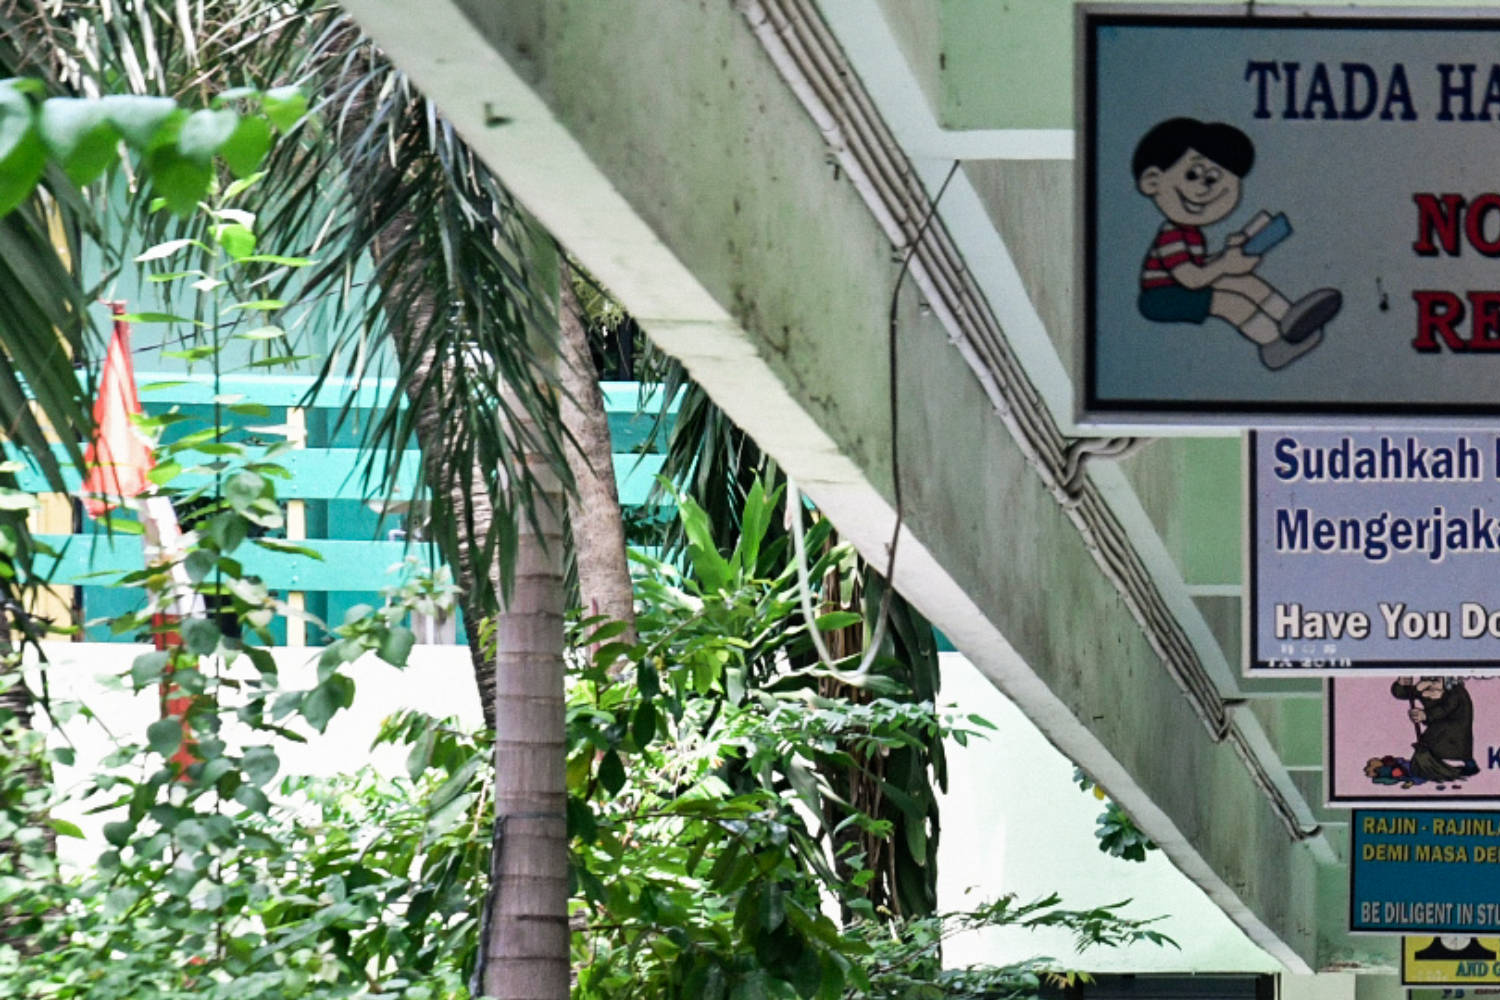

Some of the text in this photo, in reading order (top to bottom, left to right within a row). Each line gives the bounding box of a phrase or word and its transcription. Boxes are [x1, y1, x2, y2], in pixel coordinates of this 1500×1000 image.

[1244, 60, 1418, 120] TIADA
[1274, 437, 1481, 480] Sudahkah
[1275, 603, 1370, 639] Have
[1378, 603, 1450, 639] You
[1363, 816, 1417, 835] RAJIN
[1362, 843, 1410, 861] DEMI
[1415, 844, 1468, 863] MASA
[1361, 901, 1380, 923] BE
[1384, 902, 1453, 924] DILIGENT
[1457, 903, 1474, 924] IN
[1456, 962, 1487, 977] AND
